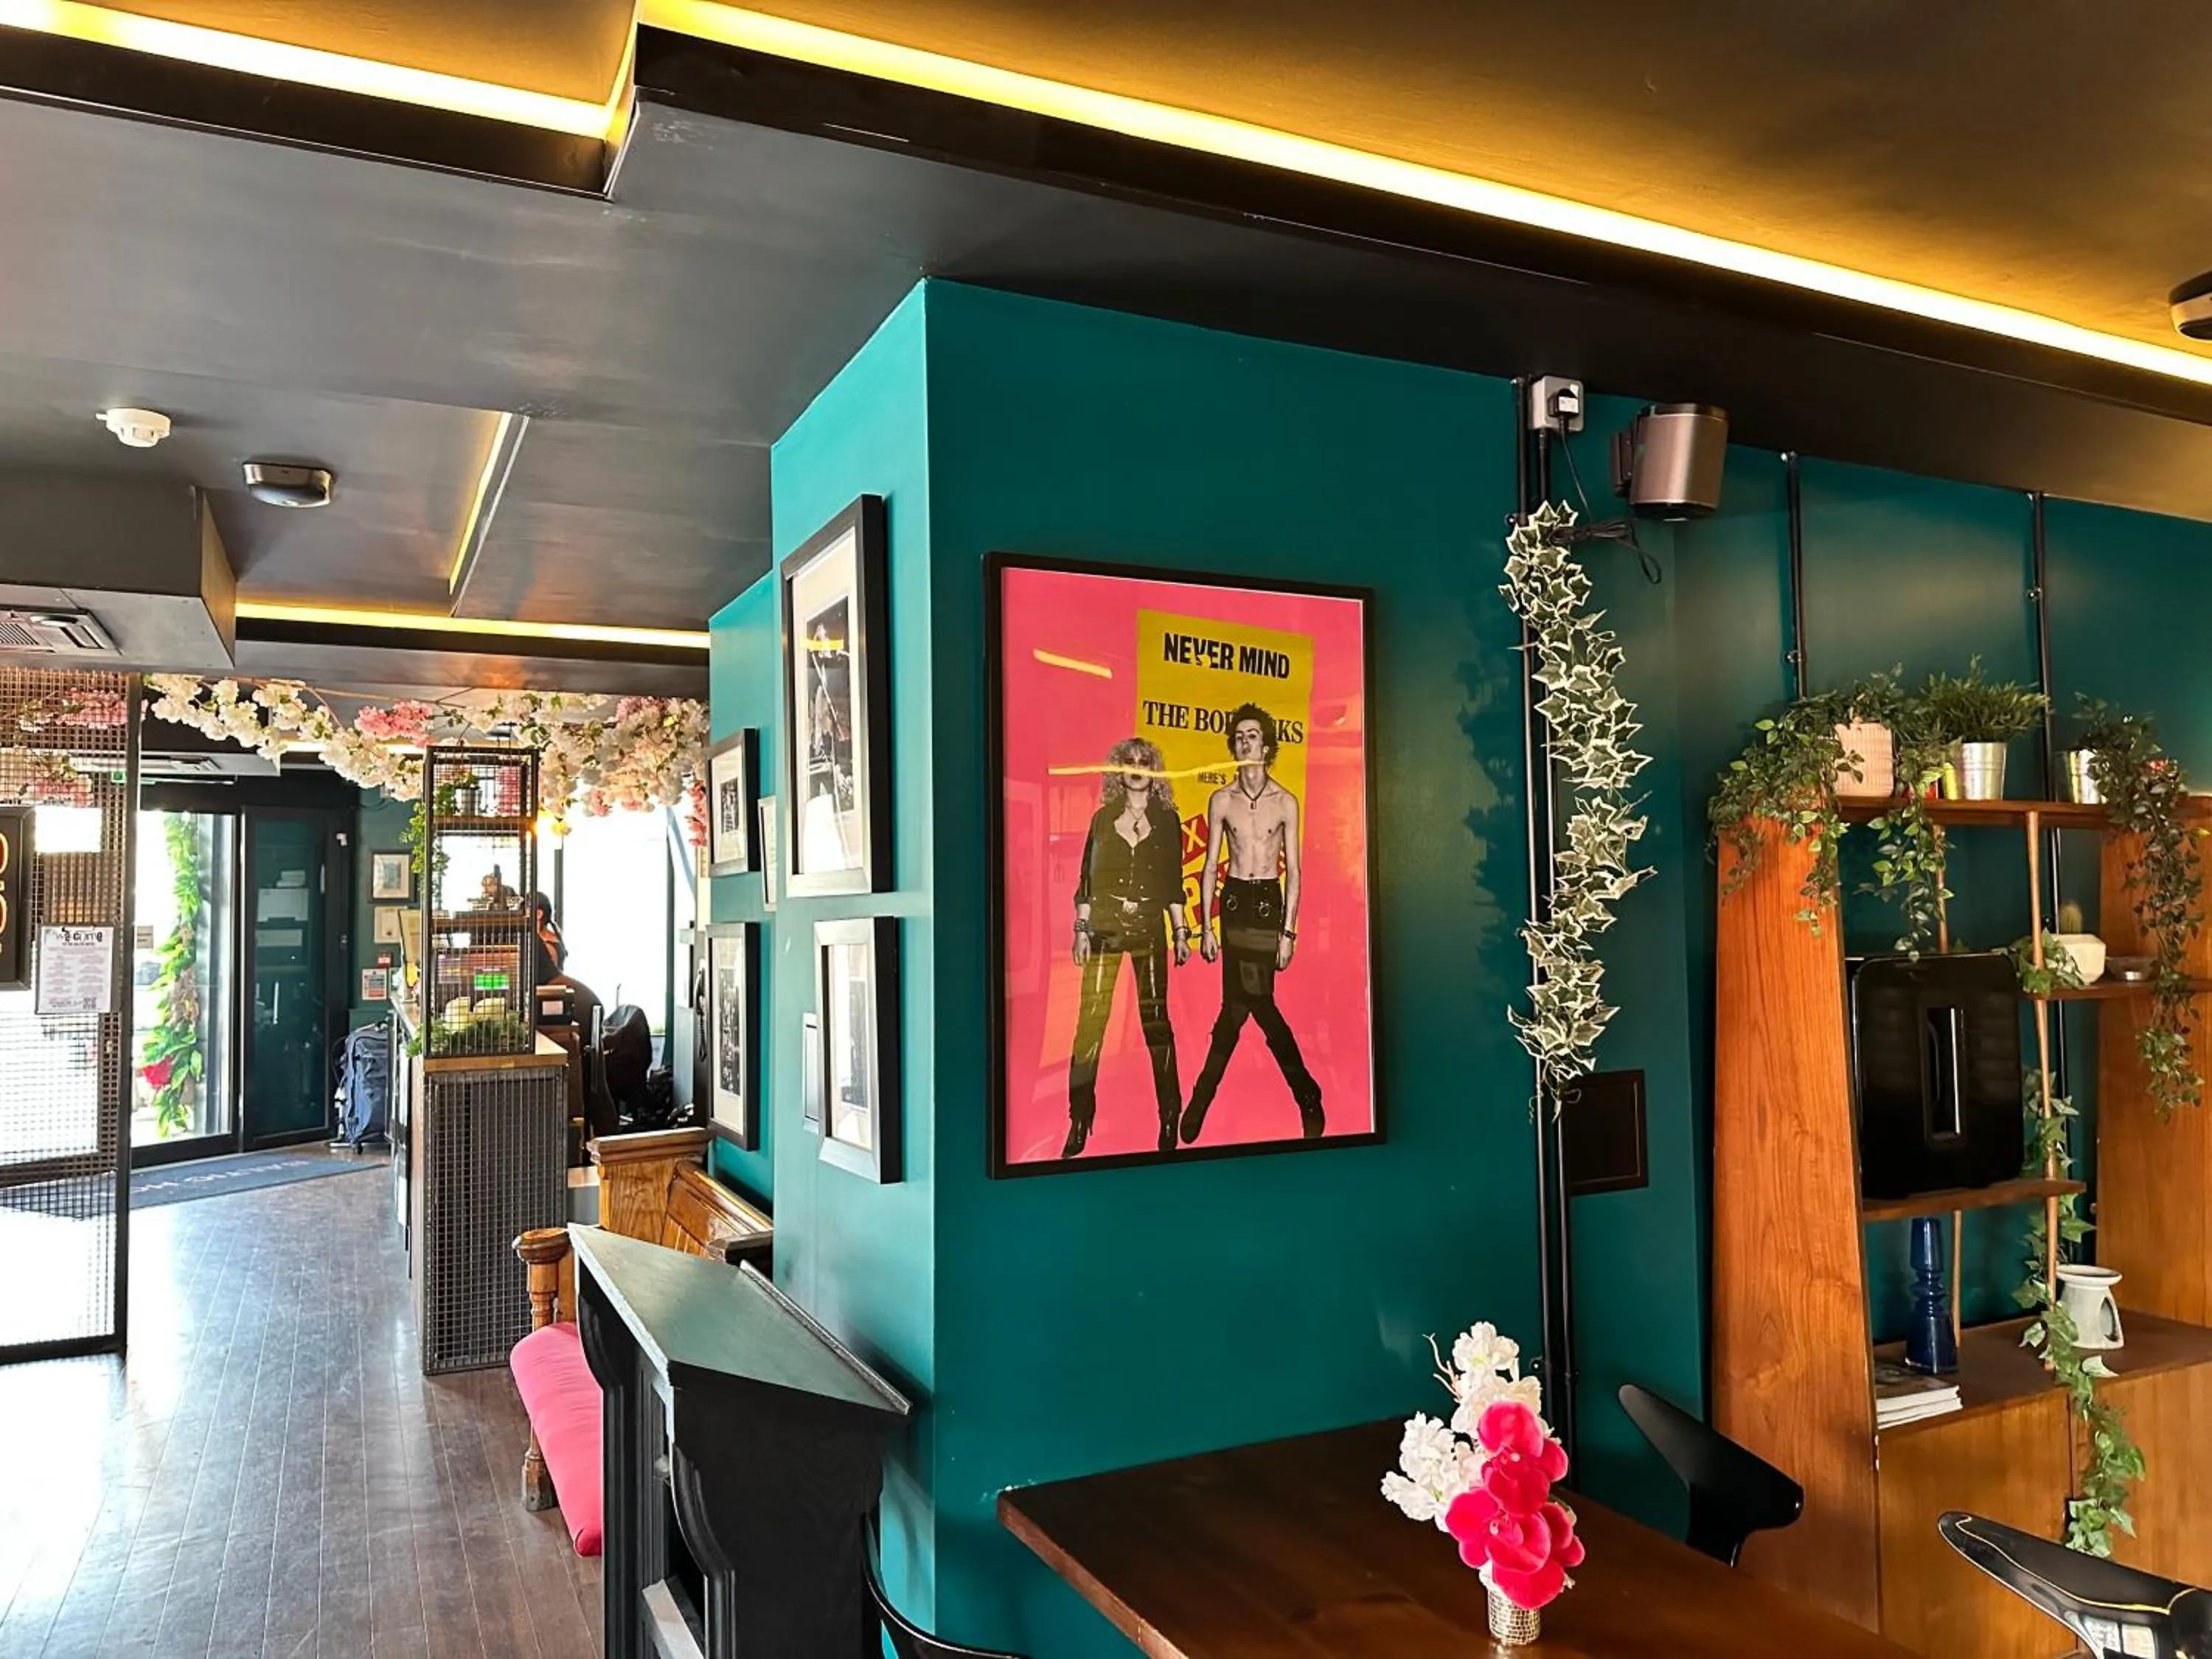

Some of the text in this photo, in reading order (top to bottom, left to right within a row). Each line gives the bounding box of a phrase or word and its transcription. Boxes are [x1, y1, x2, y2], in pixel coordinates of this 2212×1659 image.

[1164, 632, 1290, 679] NEVER MIND
[1143, 700, 1304, 744] THE BOKS
